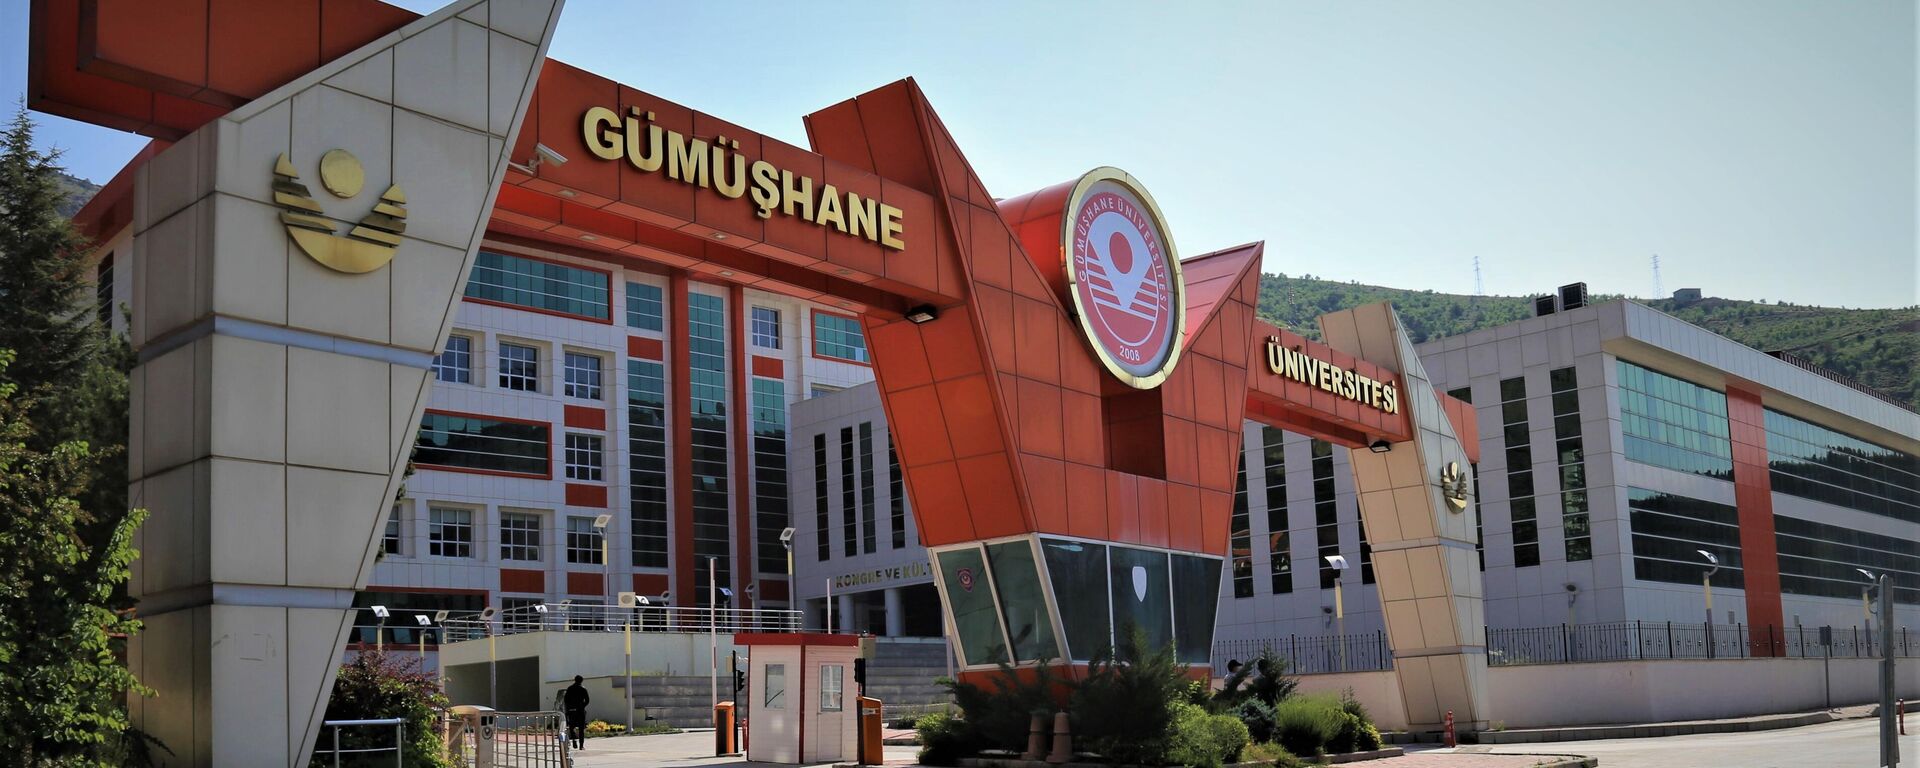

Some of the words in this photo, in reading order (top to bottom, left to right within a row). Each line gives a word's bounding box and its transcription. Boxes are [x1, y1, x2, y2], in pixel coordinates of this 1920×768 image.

[583, 105, 905, 251] GÜMÜŞHANE
[1075, 197, 1115, 282] GÜMÜŞHANE
[1119, 345, 1141, 362] 2008
[836, 570, 882, 588] KONGRE
[885, 567, 900, 579] VE
